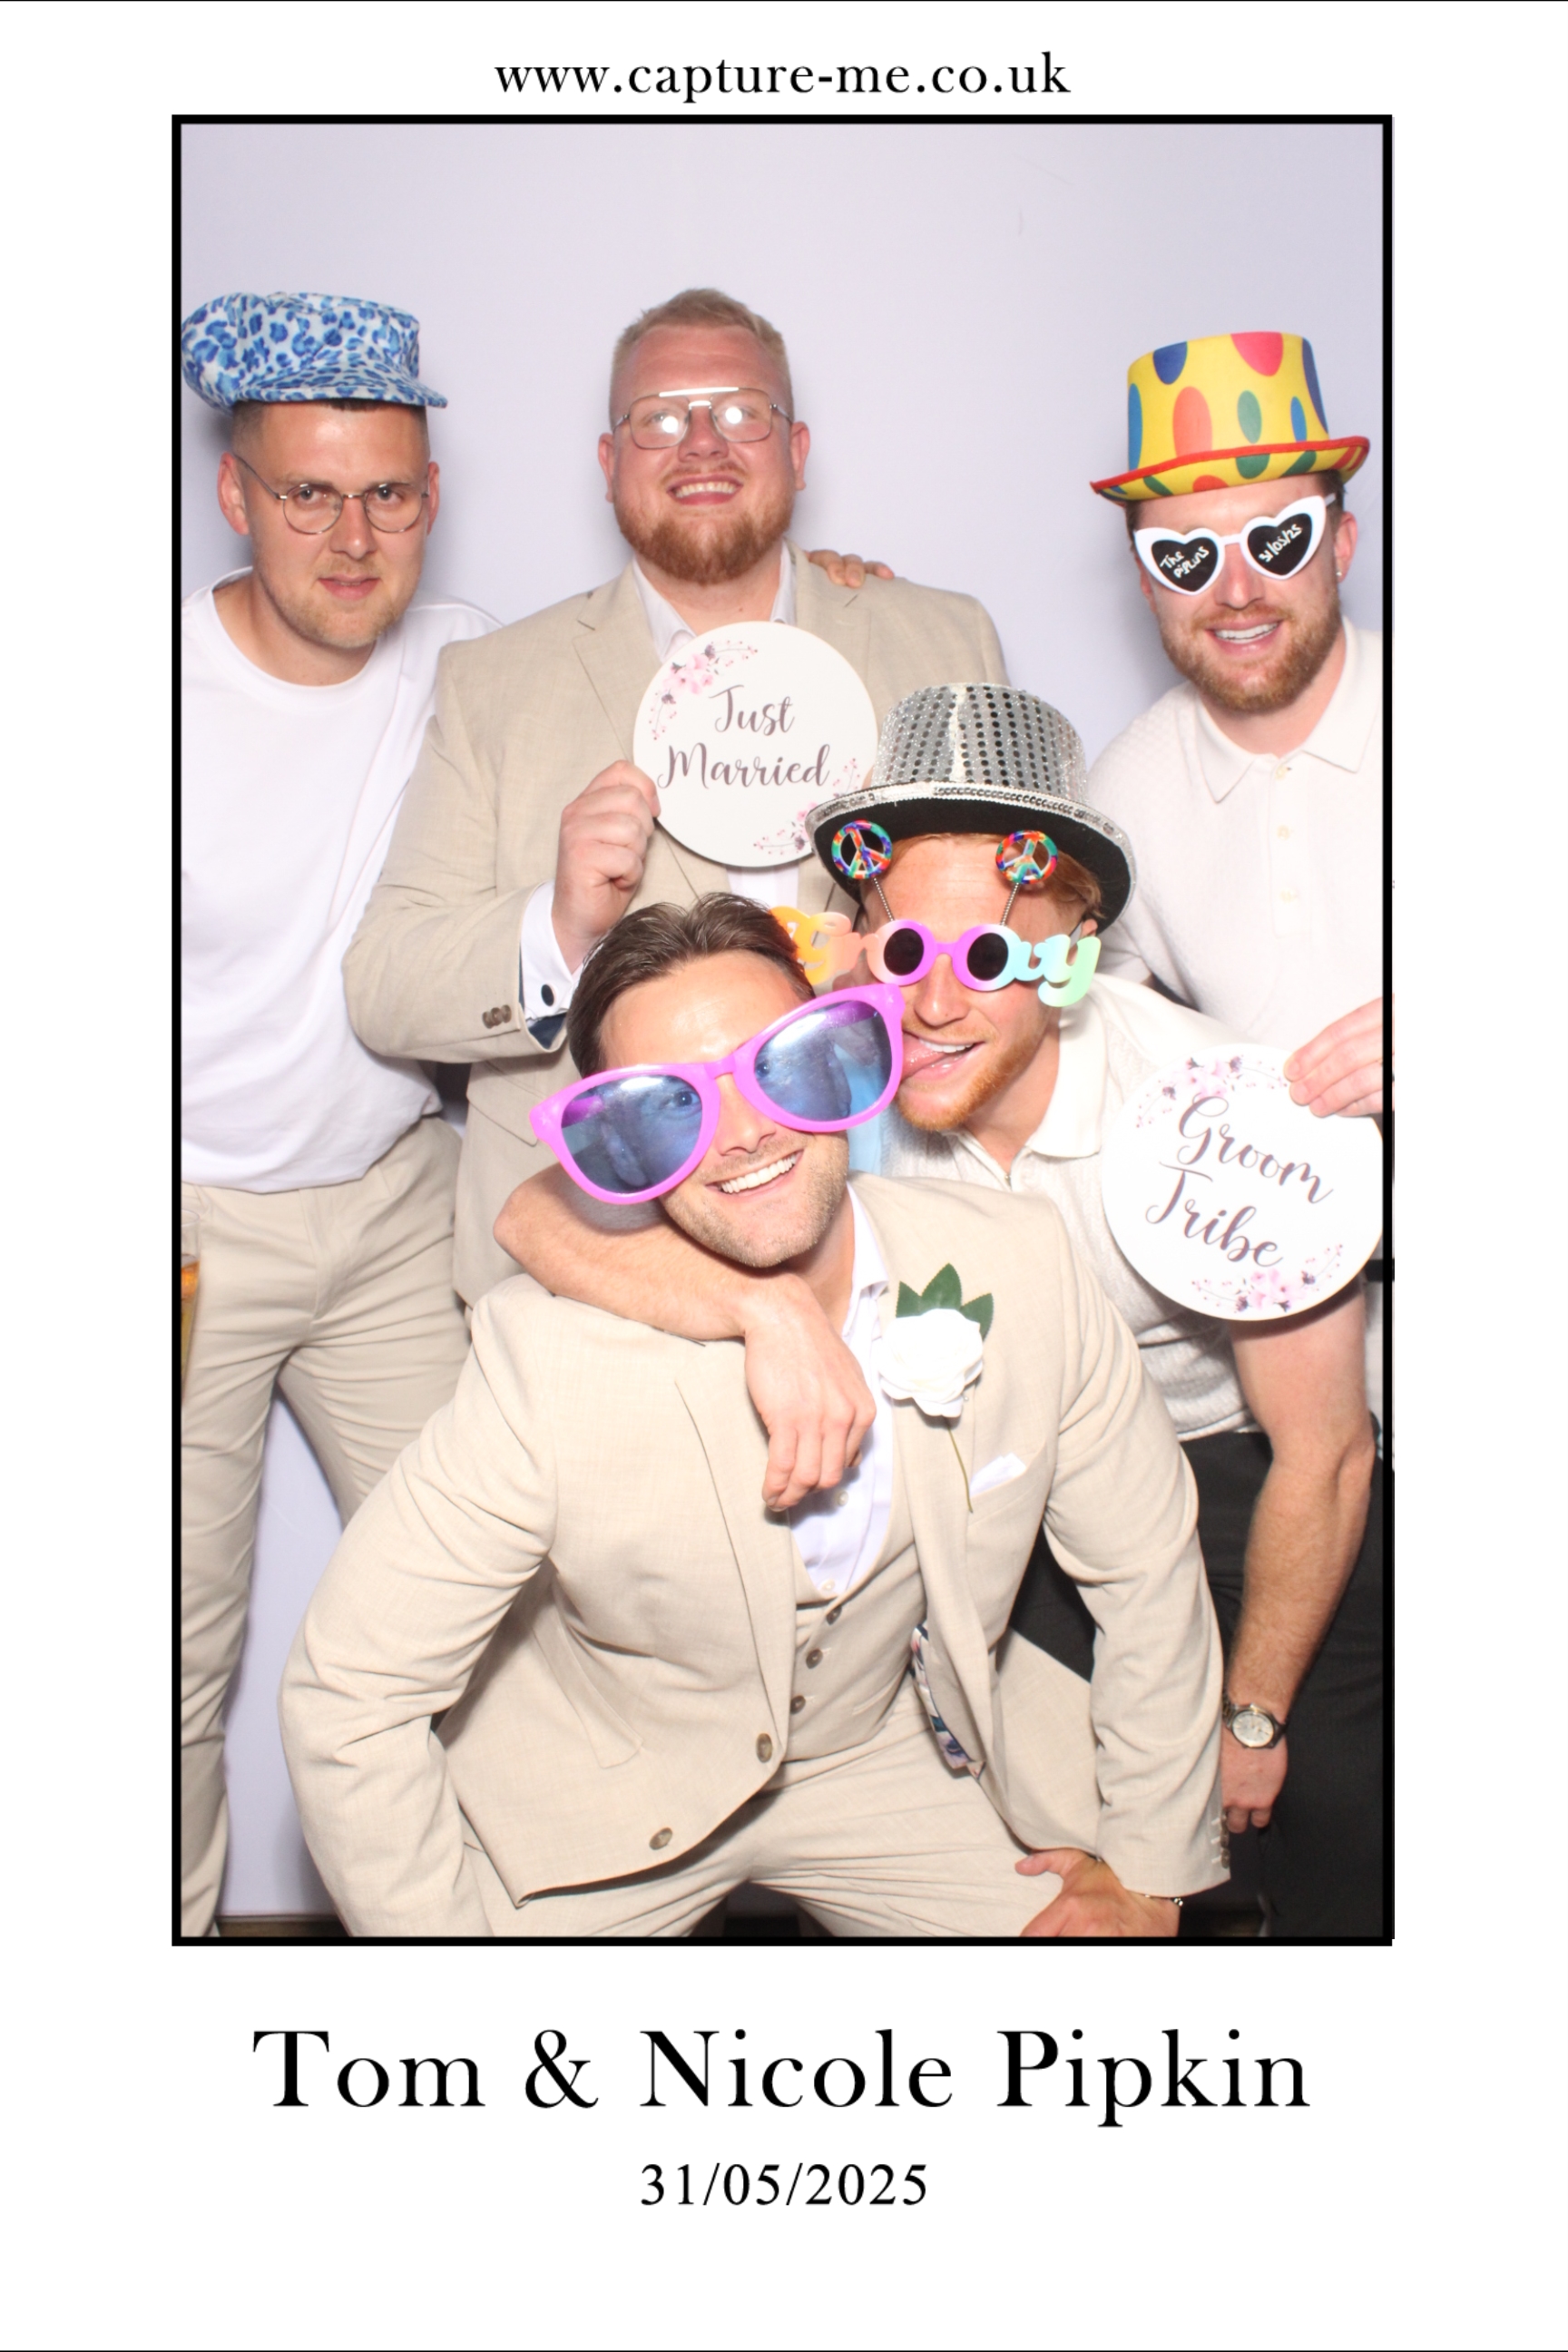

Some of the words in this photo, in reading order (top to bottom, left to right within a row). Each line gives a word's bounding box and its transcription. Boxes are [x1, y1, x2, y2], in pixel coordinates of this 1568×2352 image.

[1159, 551, 1185, 569] The
[708, 684, 795, 736] Just
[656, 742, 831, 789] Married
[1177, 1092, 1334, 1204] Groom
[1145, 1161, 1284, 1267] Tribe
